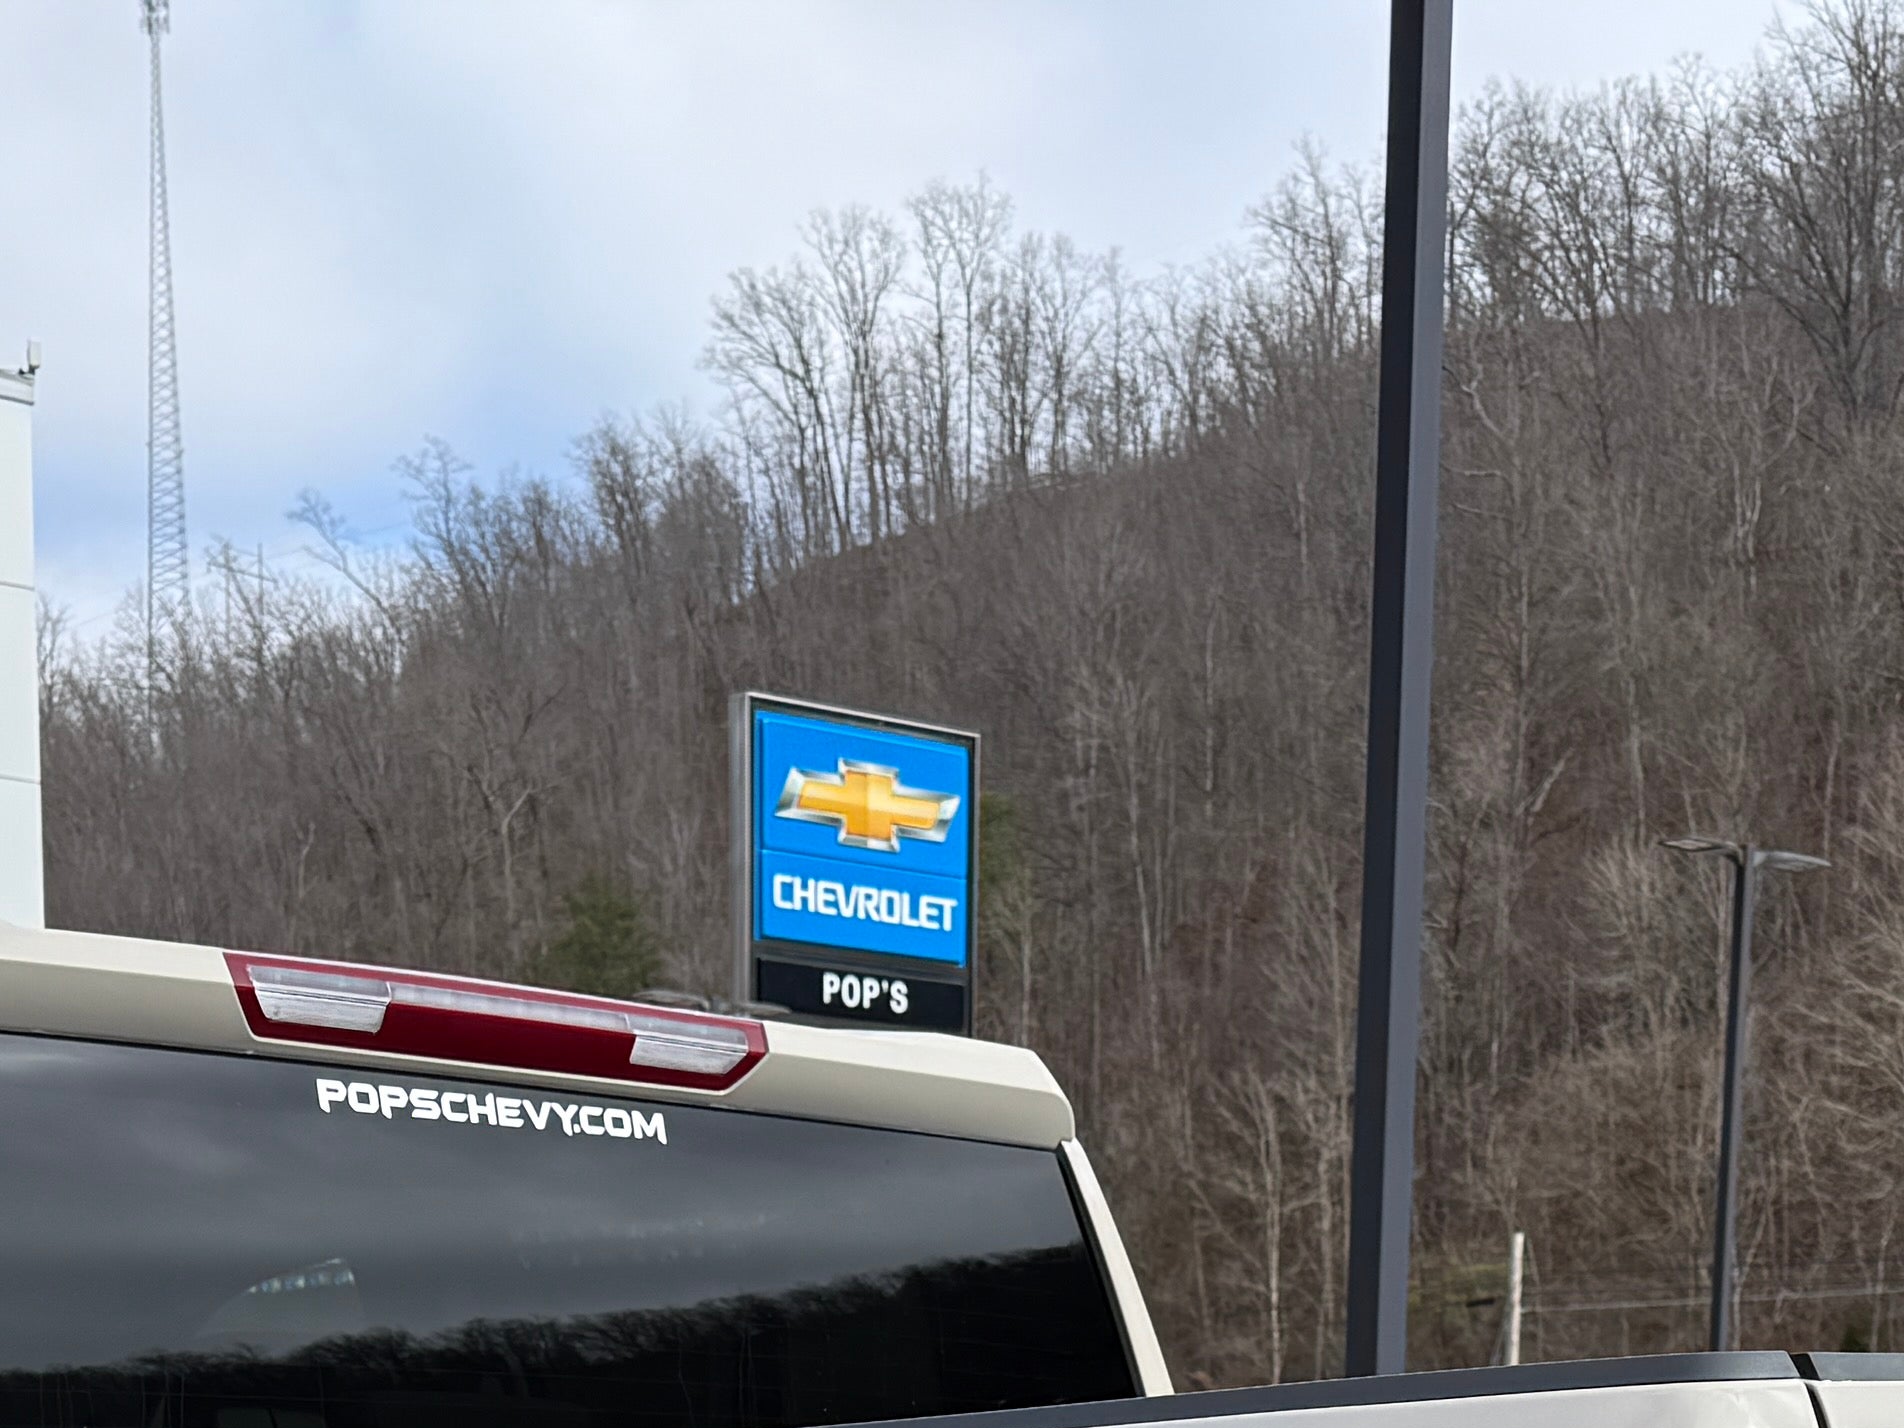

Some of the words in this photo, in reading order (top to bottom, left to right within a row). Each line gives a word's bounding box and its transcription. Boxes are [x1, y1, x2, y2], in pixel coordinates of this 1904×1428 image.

[772, 873, 959, 932] CHEVROLET
[822, 972, 909, 1014] POP'S
[315, 1077, 668, 1146] POPSCHEVY.COM
